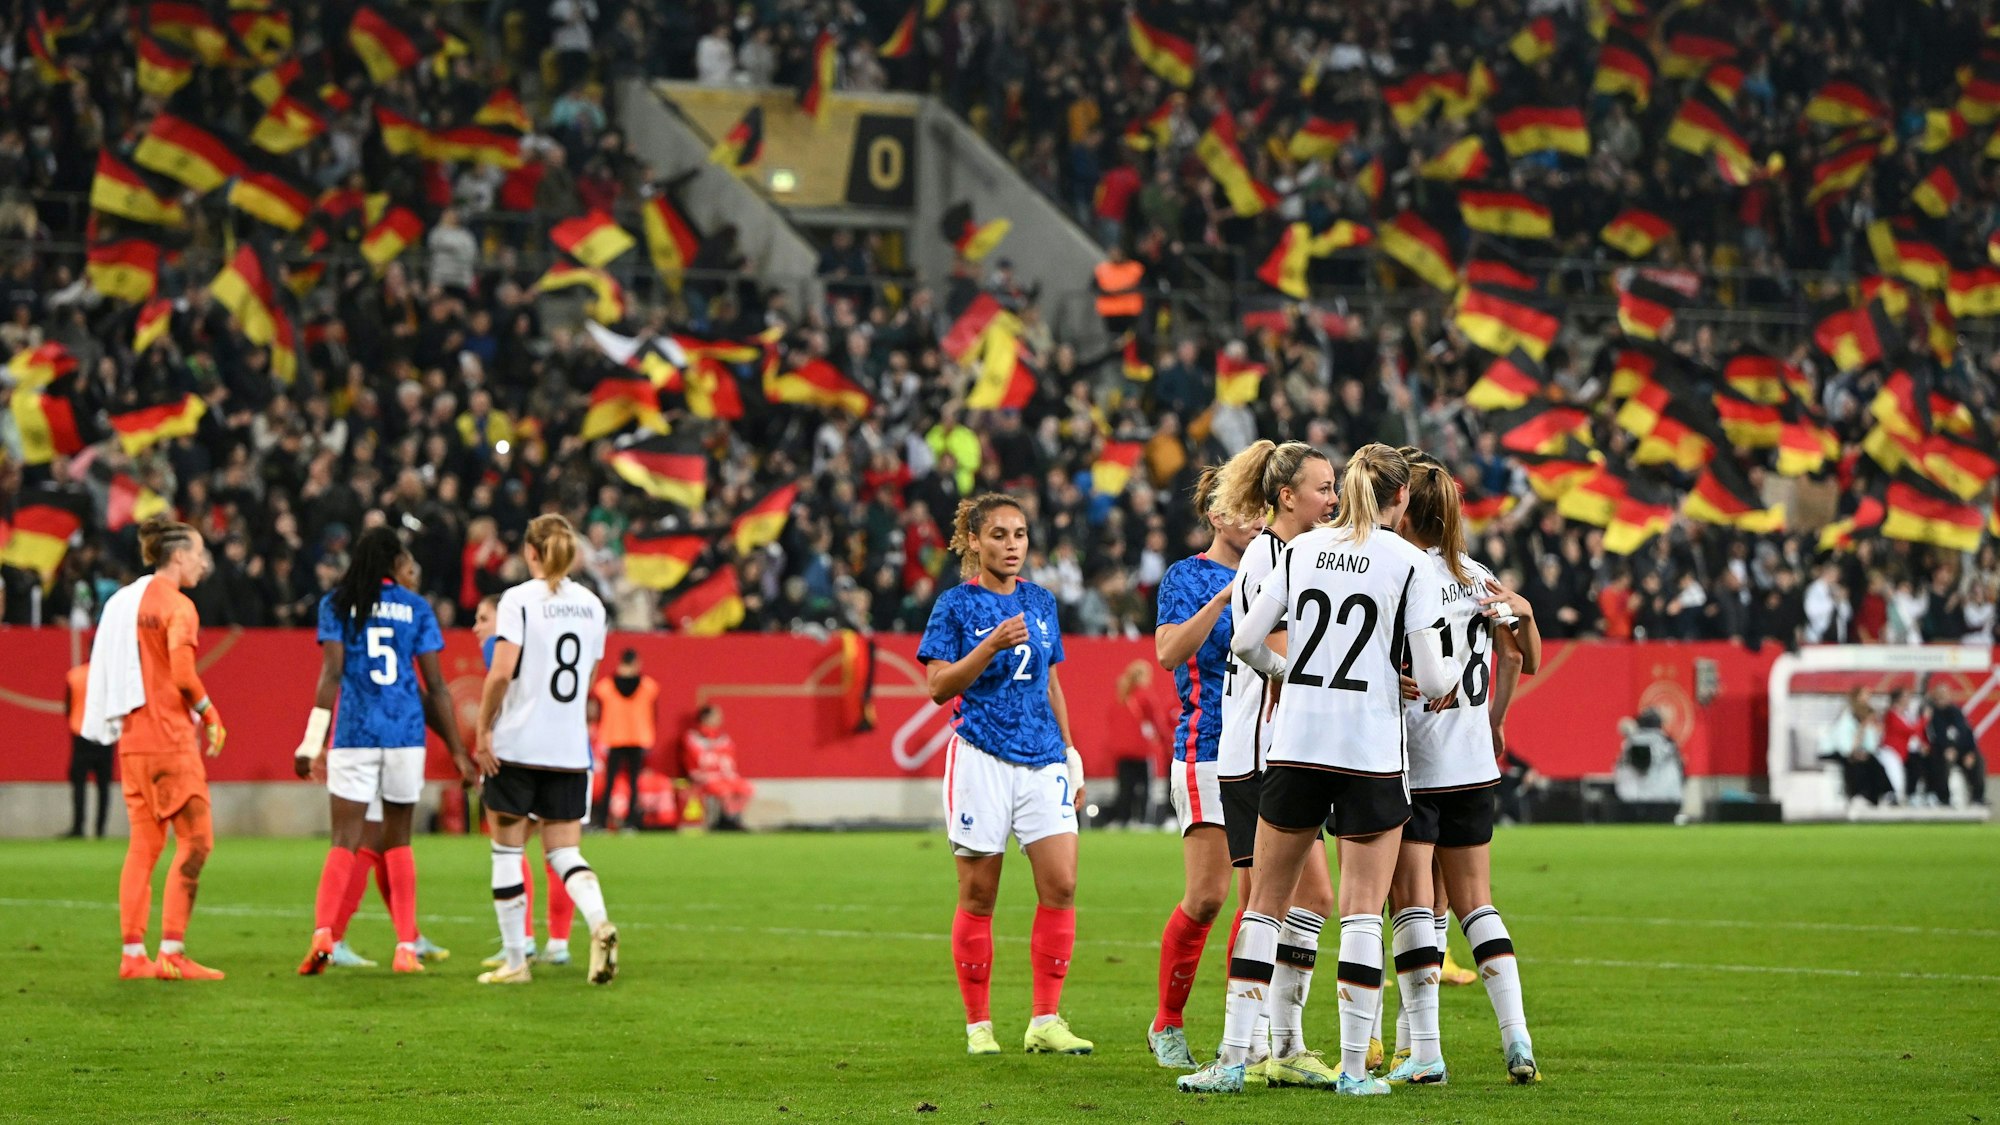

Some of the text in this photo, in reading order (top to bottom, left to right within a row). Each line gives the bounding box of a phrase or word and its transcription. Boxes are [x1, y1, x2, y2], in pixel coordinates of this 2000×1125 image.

[1315, 551, 1370, 574] BRAND
[542, 604, 594, 619] LOHMANN
[367, 627, 398, 686] 5
[1287, 588, 1378, 692] 22
[550, 632, 581, 703] 8
[1013, 644, 1032, 680] 2
[1424, 612, 1490, 712] 18
[1056, 776, 1072, 807] 2
[1292, 951, 1315, 962] DFB
